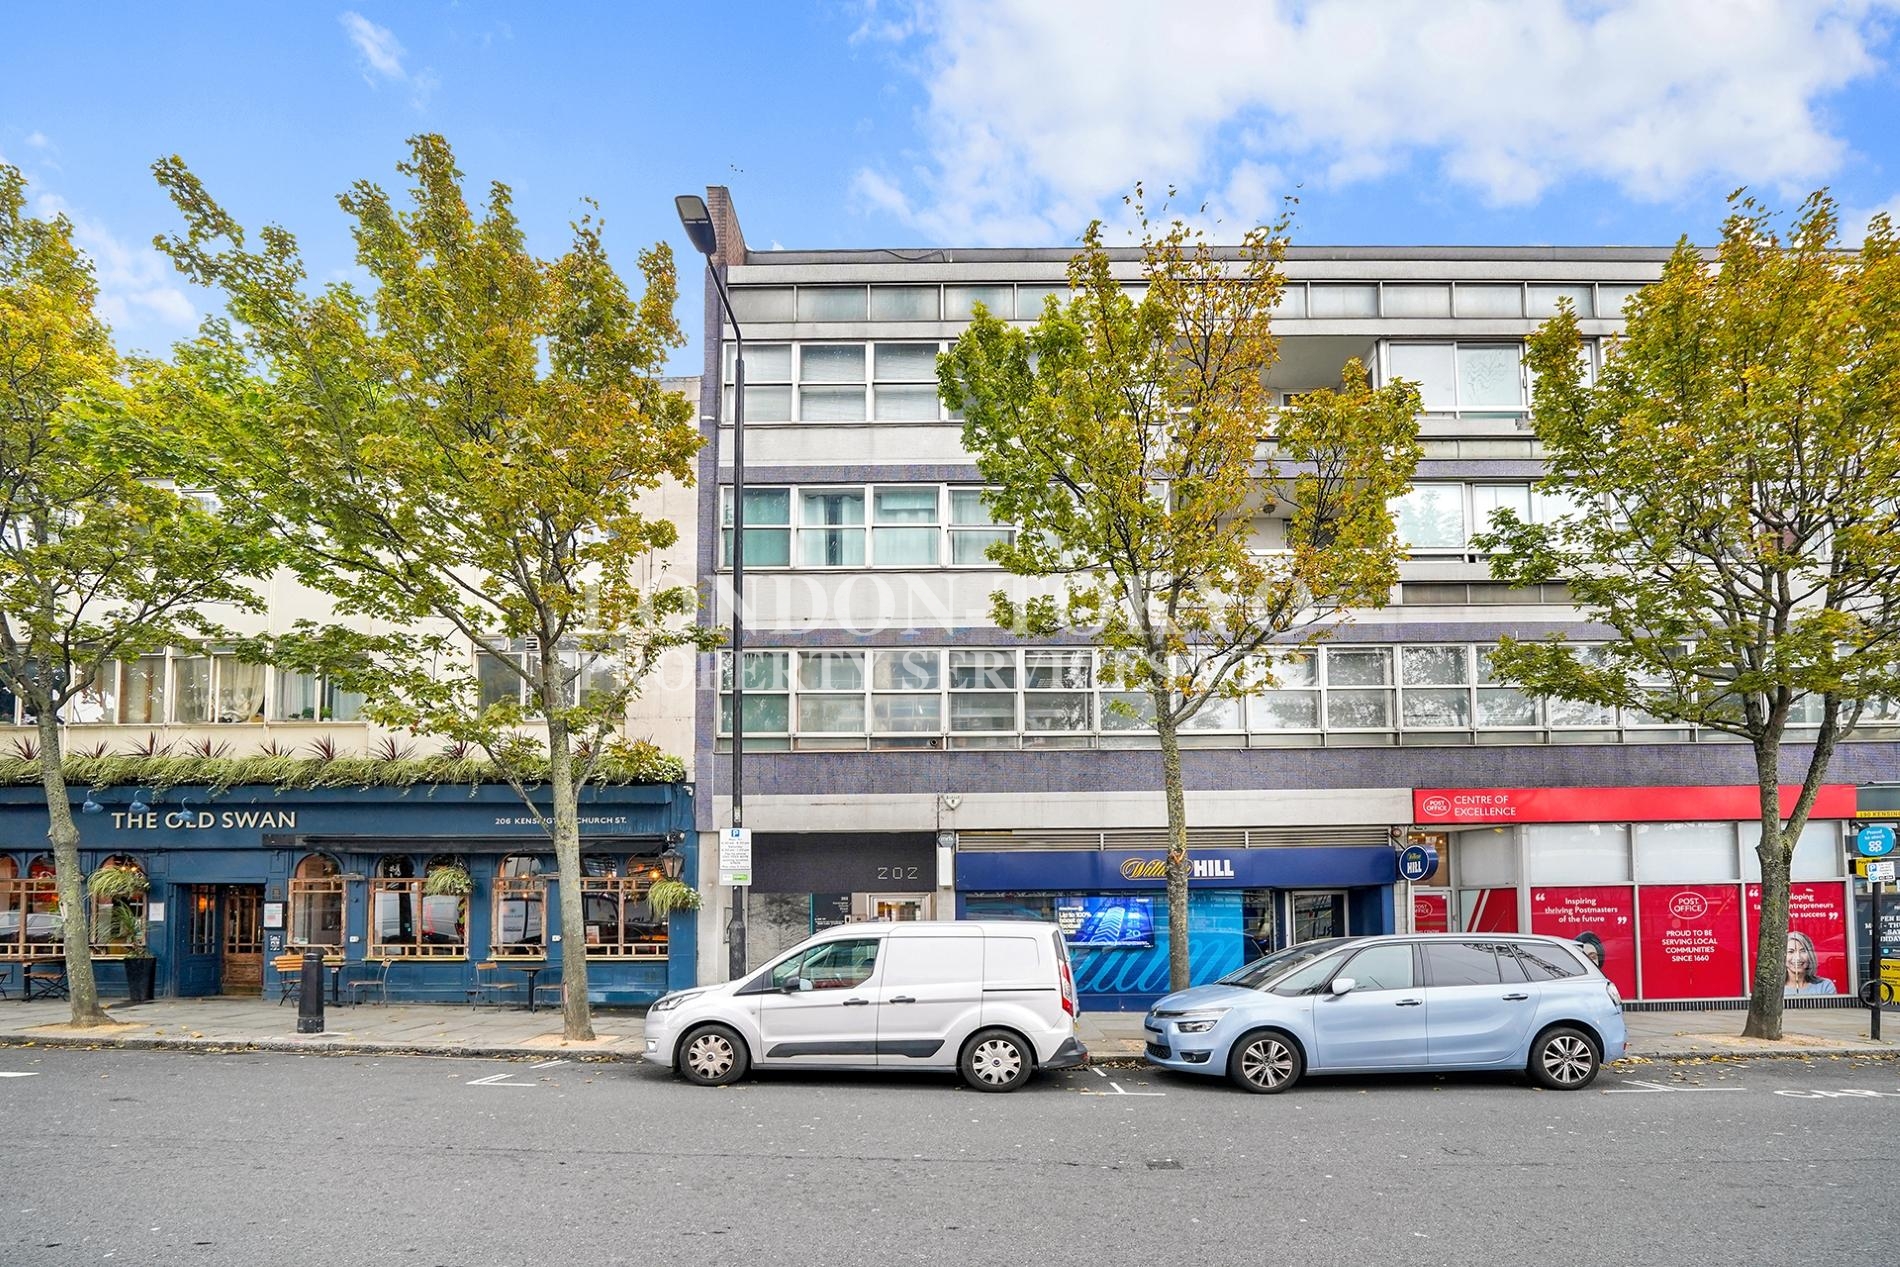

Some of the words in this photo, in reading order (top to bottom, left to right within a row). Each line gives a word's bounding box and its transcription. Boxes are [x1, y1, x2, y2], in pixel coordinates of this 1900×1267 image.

[1453, 795, 1492, 805] CENTRE
[1494, 795, 1509, 804] OF
[1453, 806, 1517, 816] EXCELLENCE
[111, 811, 158, 829] THE
[221, 811, 297, 829] SWAN
[494, 817, 512, 825] 206
[1193, 859, 1235, 877] HILL
[1406, 861, 1423, 874] HILL
[1565, 897, 1597, 906] Inspiring
[1678, 897, 1700, 905] POST
[1545, 906, 1573, 915] thriving
[1574, 906, 1618, 914] Postmasters
[1673, 904, 1703, 912] OFFICE
[1558, 915, 1567, 923] of
[1568, 915, 1580, 923] the
[1581, 914, 1605, 922] future
[1800, 911, 1827, 919] success
[1692, 929, 1703, 937] TO
[1704, 929, 1713, 937] BE
[1661, 938, 1693, 946] SERVING
[1665, 946, 1715, 954] COMMUNITIES
[1694, 954, 1710, 962] 1660
